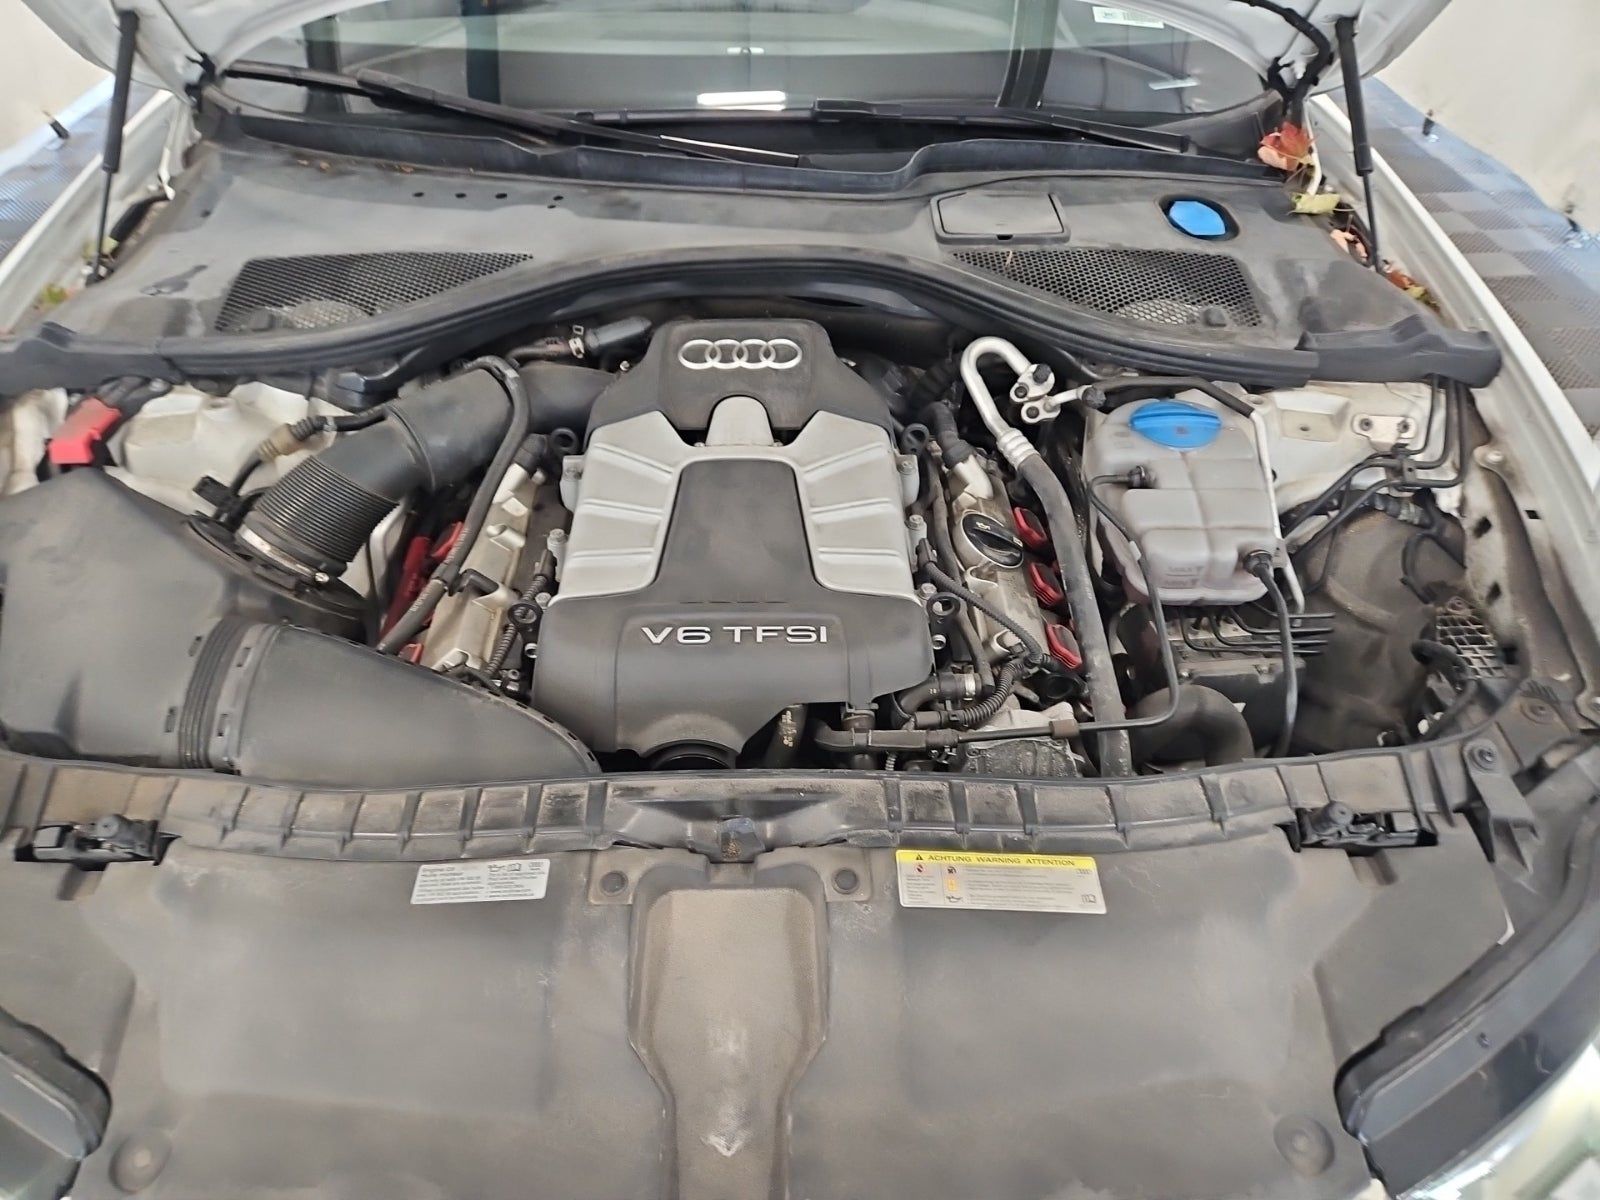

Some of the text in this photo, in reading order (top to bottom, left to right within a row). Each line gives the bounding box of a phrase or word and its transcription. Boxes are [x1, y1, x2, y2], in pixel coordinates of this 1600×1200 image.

[641, 625, 828, 644] V6 TFSI
[928, 855, 972, 863] ACHTUNG
[1026, 858, 1075, 866] ATTENTION
